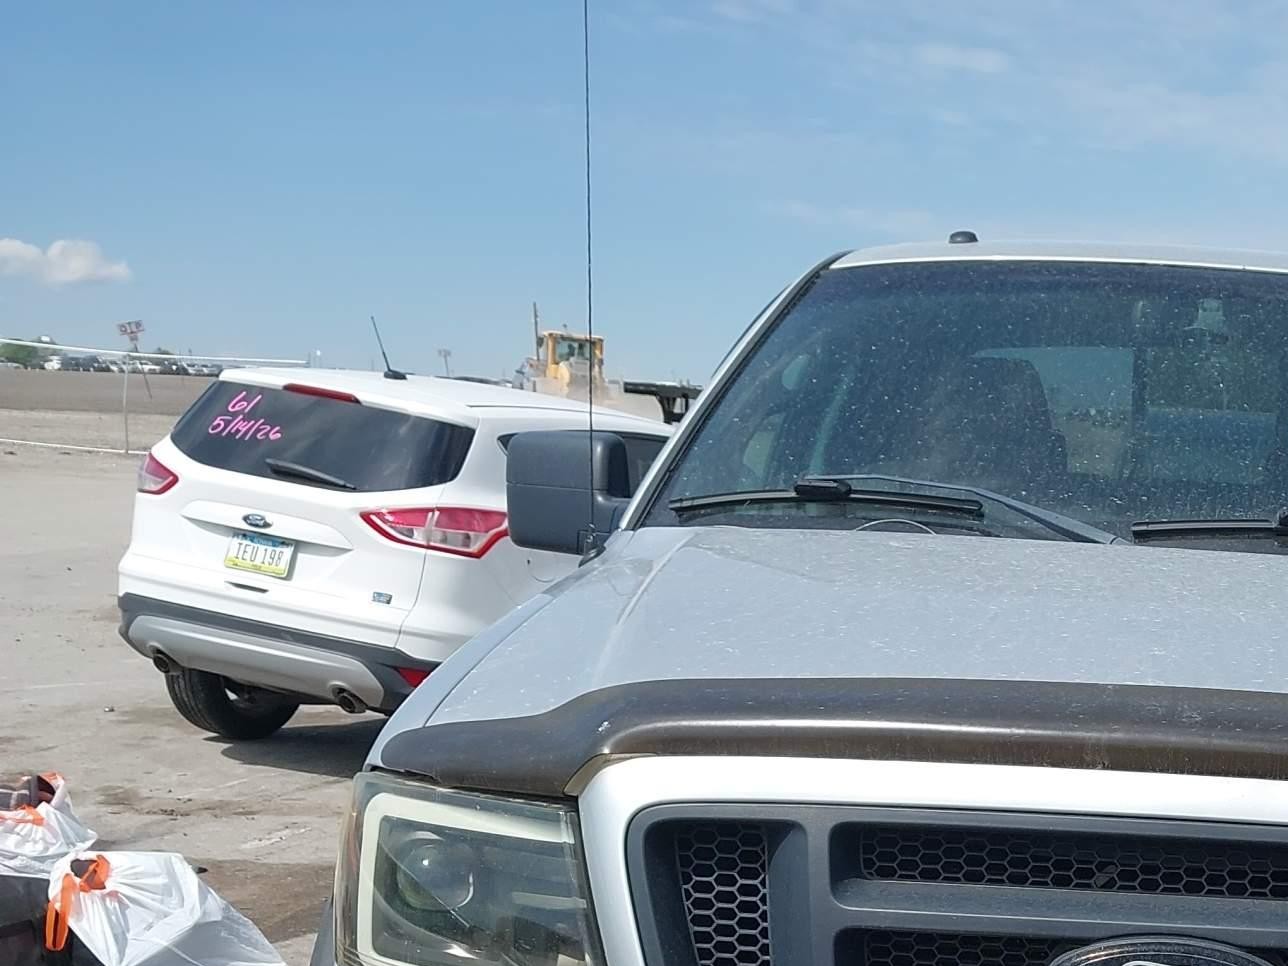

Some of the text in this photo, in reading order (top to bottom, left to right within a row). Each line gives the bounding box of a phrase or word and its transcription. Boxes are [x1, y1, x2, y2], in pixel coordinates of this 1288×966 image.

[228, 391, 262, 413] 61
[208, 415, 282, 441] 5/14/26
[233, 542, 259, 563] IEU
